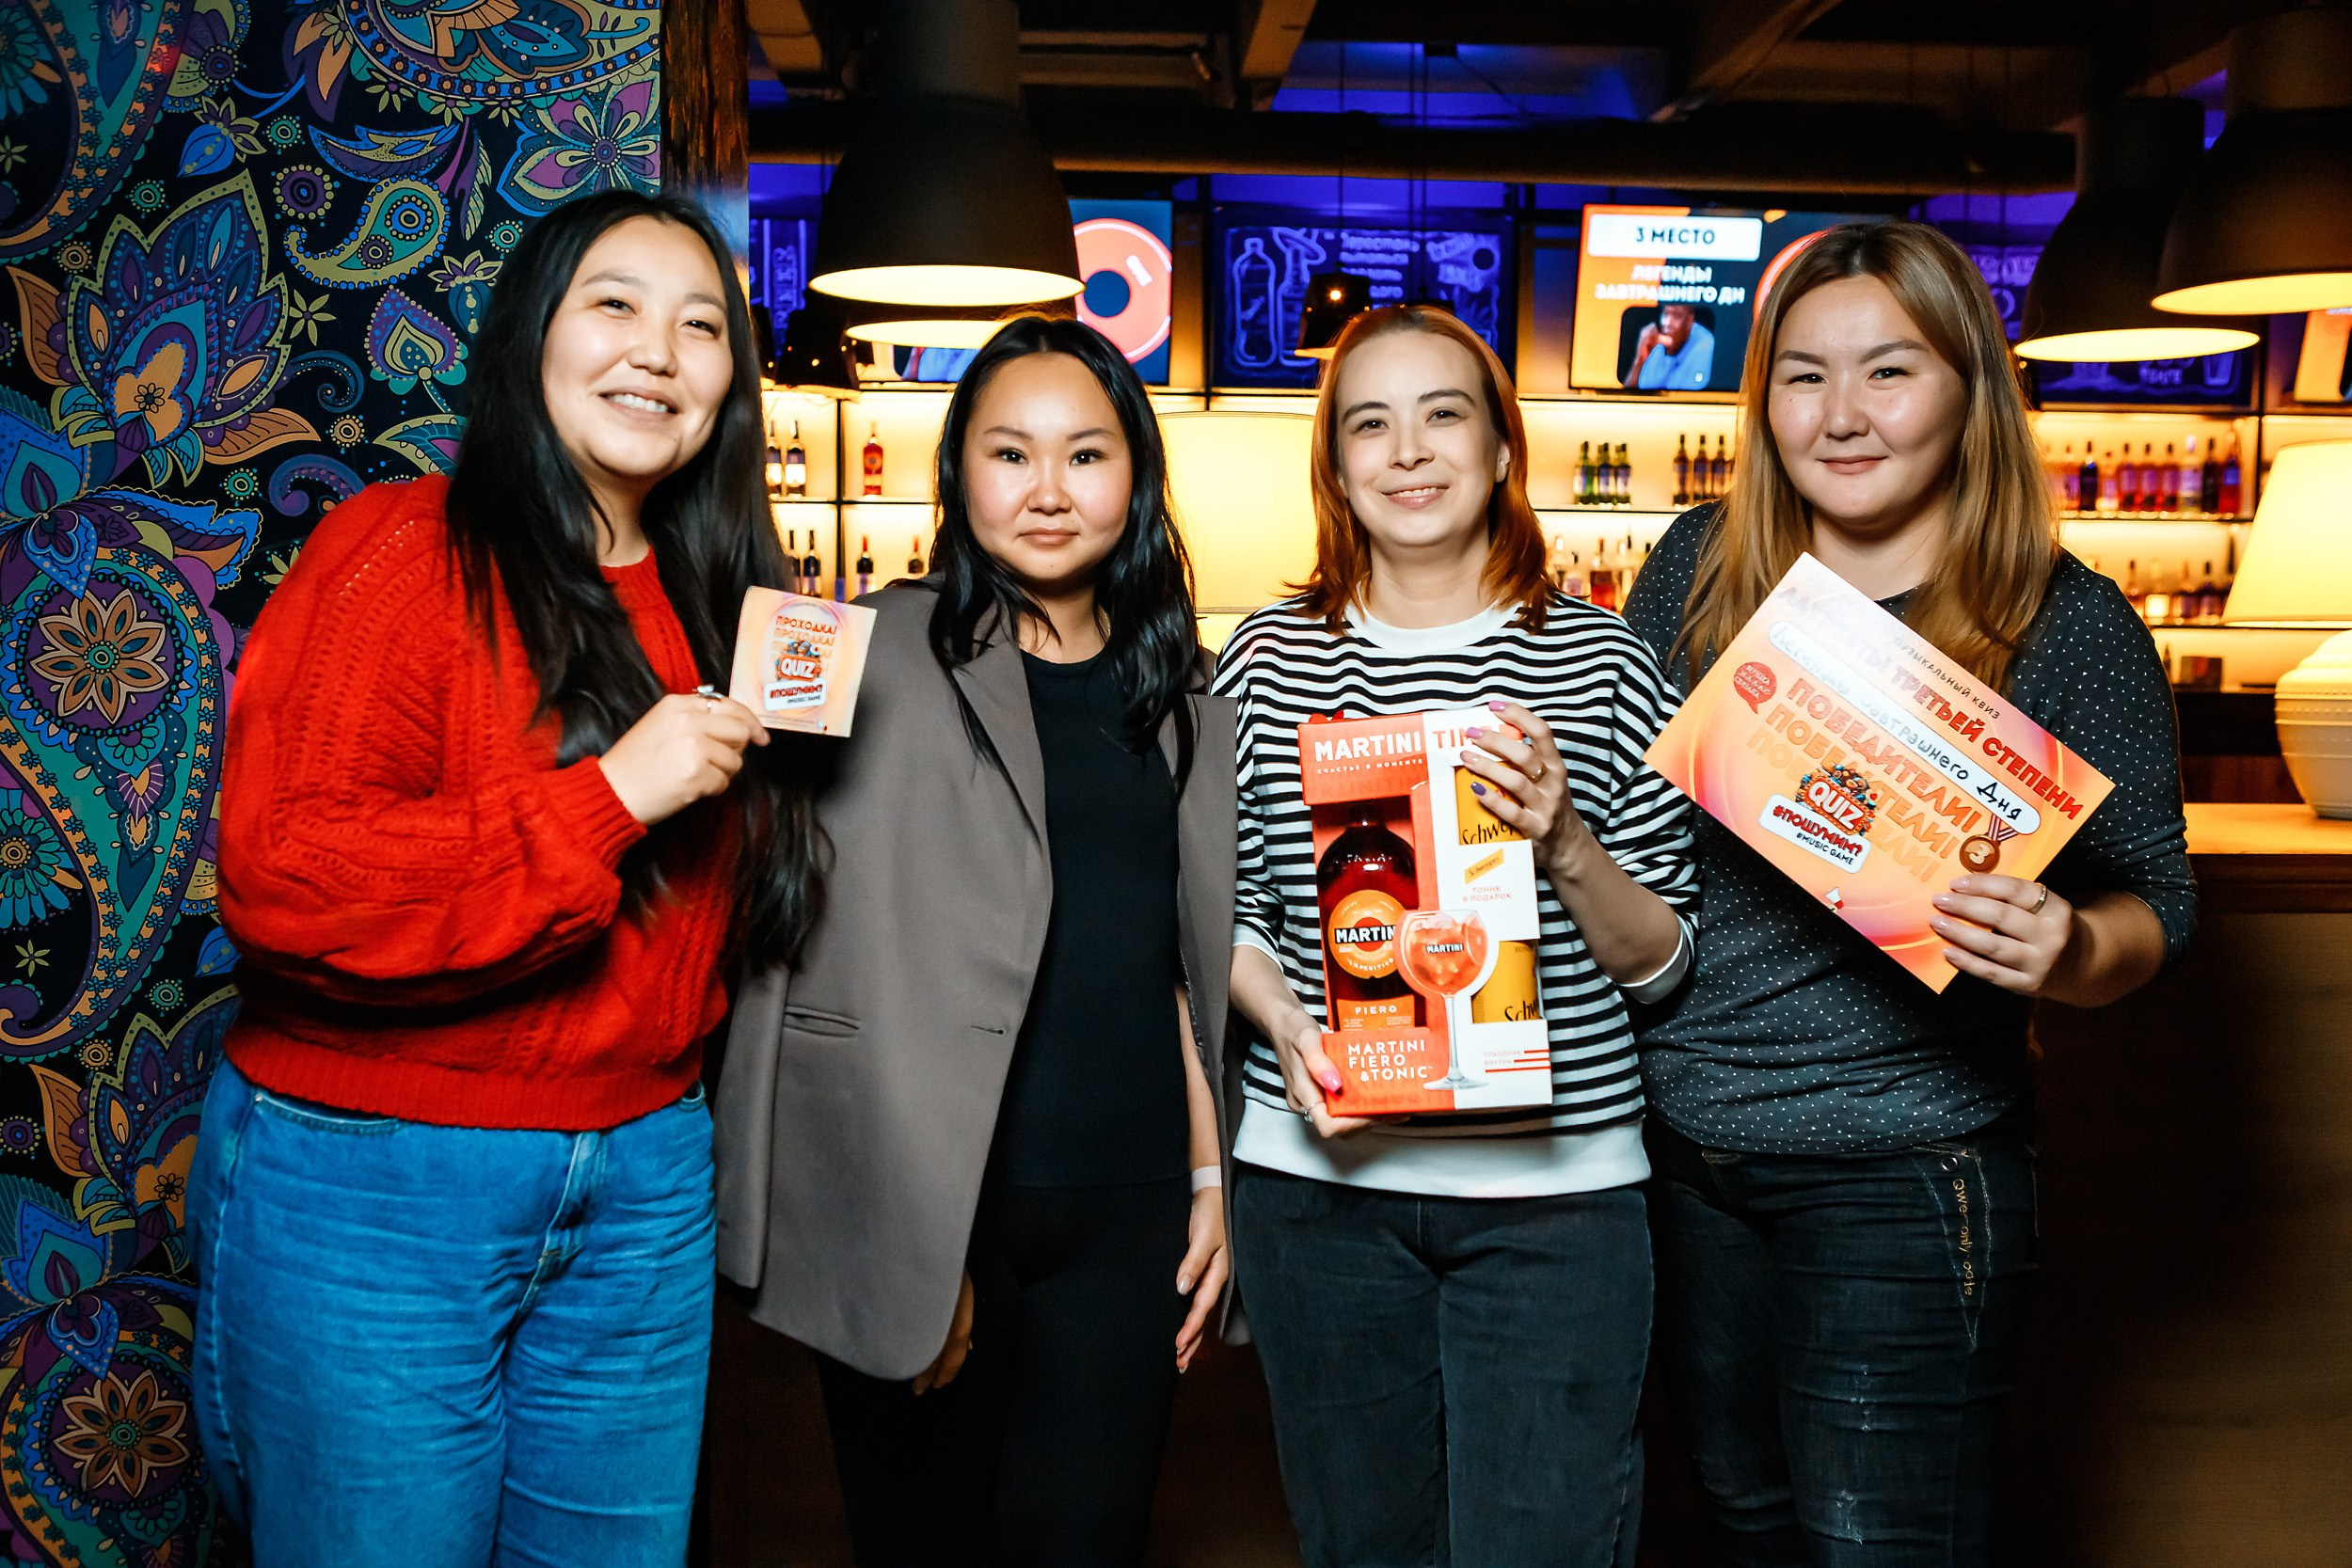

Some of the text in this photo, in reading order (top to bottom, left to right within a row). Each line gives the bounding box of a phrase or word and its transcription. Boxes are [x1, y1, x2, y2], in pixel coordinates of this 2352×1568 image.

[1636, 228, 1716, 245] 3 МЕСТО
[1630, 264, 1712, 284] ЛЕГЕНДЫ
[1595, 283, 1718, 303] ЗАВТРАШНЕГО
[775, 615, 837, 635] ПРОХОДКА!
[781, 657, 816, 678] QUIZ
[1894, 637, 2001, 720] МУЗЫКАЛЬНЫЙ КВИЗ
[1314, 731, 1422, 763] MARTINI
[1891, 667, 1985, 743] ТРЕТЬЕЙ
[1982, 737, 2085, 820] СТЕПЕНИ
[1787, 677, 1982, 833] ПОБЕДИТЕЛИ!
[1317, 764, 1360, 775] СЧАСТЬЕ
[1376, 758, 1423, 768] МОМЕНТЕ
[1807, 780, 1865, 831] QUIZ
[1976, 781, 2023, 821] Дня
[1772, 804, 1863, 857] #ПОШУМИМ?
[1796, 832, 1854, 865] #MUSIC GAME
[1470, 893, 1512, 902] ПОДАРОК
[1426, 943, 1463, 954] MARTINI
[1355, 1005, 1397, 1015] FIERO
[1347, 1038, 1425, 1055] MARTINI
[1348, 1053, 1406, 1069] FIERO
